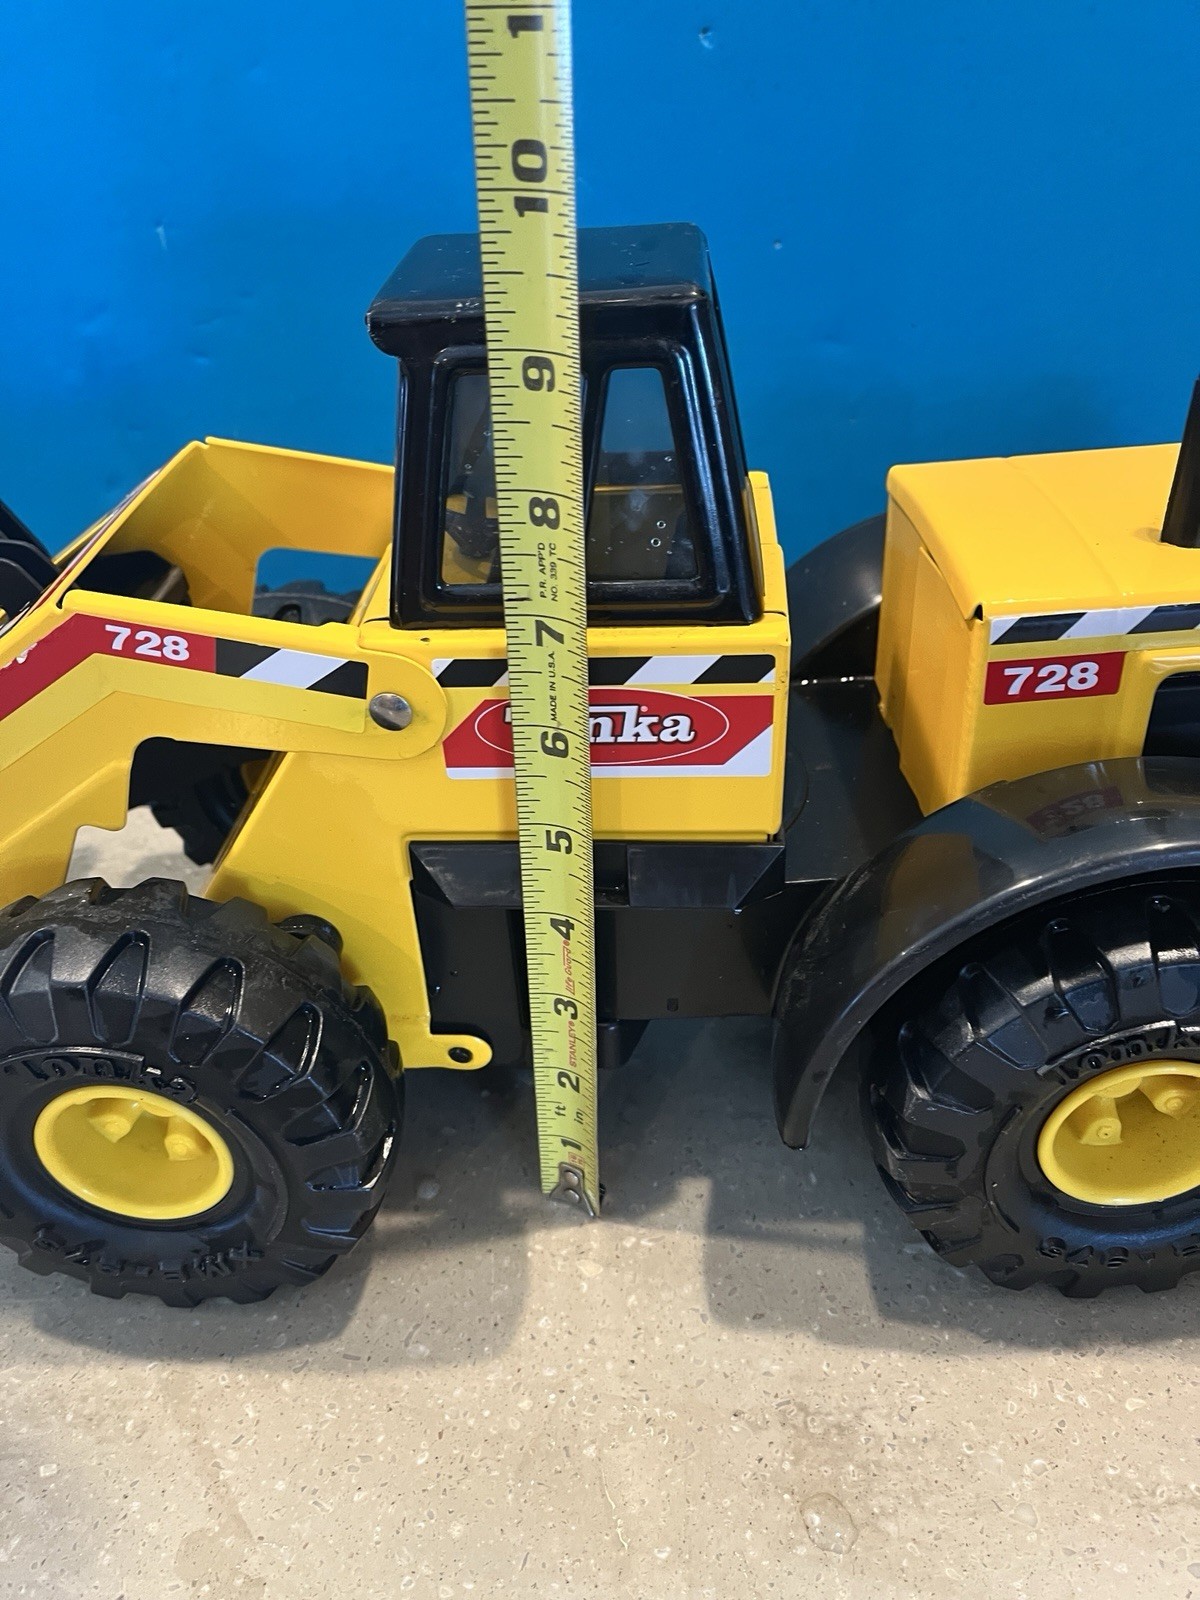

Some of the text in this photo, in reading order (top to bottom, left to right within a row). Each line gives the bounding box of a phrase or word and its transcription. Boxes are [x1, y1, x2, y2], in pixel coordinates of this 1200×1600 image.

[511, 139, 548, 217] 10
[522, 356, 555, 392] 9
[529, 497, 560, 530] 8
[548, 543, 557, 557] TC
[105, 624, 190, 661] 728
[535, 620, 564, 647] 7
[549, 681, 557, 692] IN
[1004, 661, 1099, 695] 728
[549, 695, 557, 721] MADE
[540, 731, 569, 759] 6
[545, 829, 573, 855] 5
[550, 917, 575, 941] 4
[554, 997, 579, 1021] 3
[557, 1070, 581, 1094] 2
[554, 1105, 566, 1117] ft
[574, 1110, 584, 1125] in
[560, 1138, 582, 1152] 1
